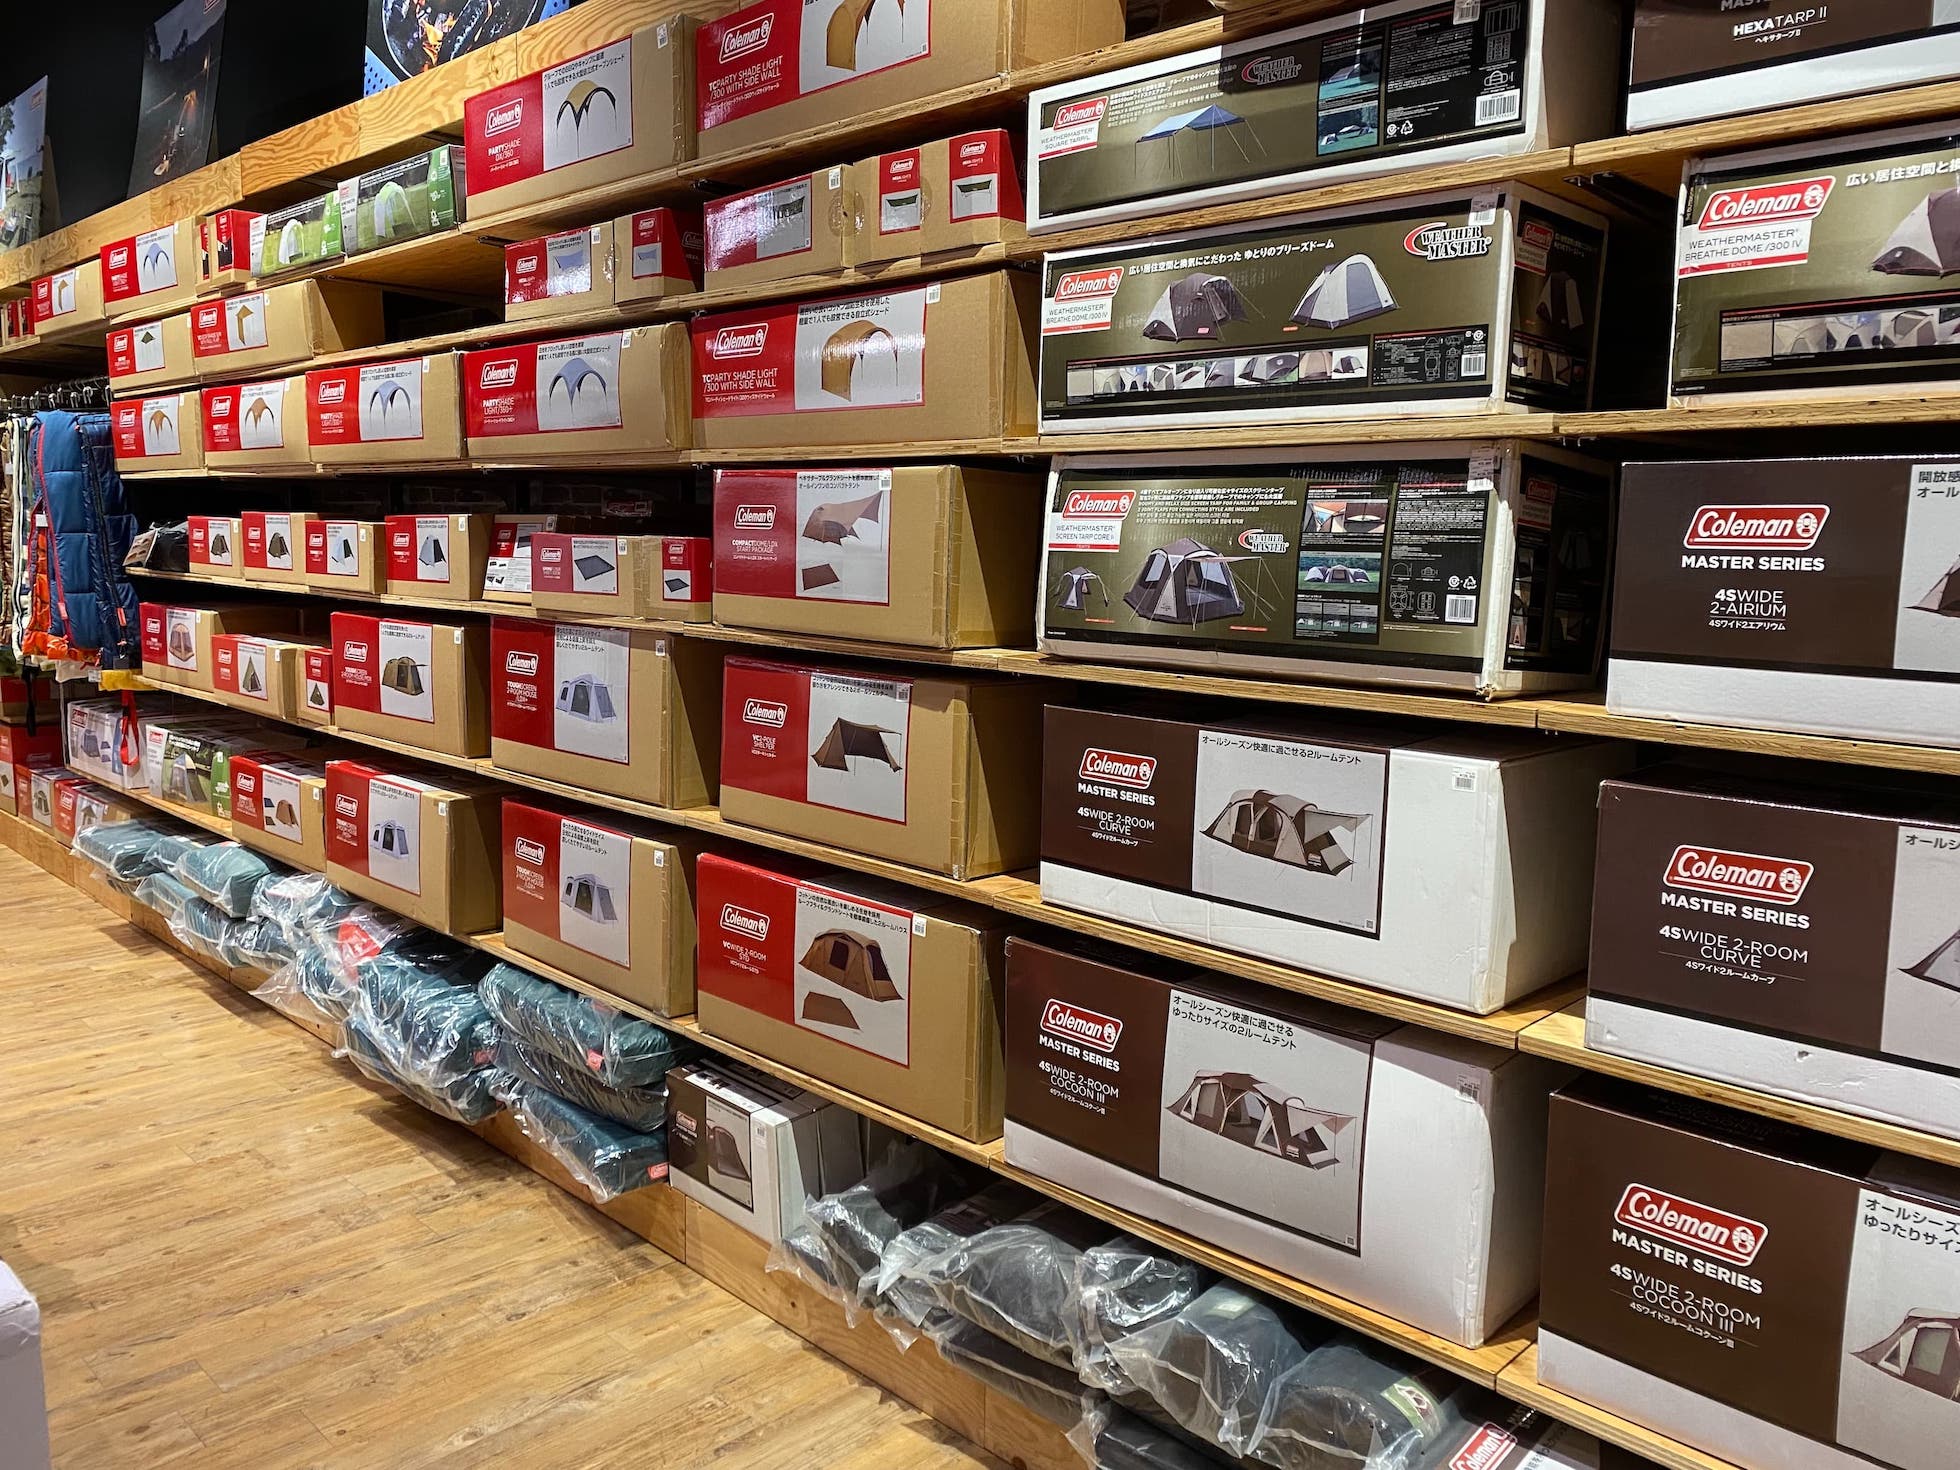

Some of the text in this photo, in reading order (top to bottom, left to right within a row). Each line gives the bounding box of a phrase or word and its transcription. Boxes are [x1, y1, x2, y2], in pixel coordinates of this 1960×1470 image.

[1733, 7, 1815, 36] HEXATARP
[725, 28, 760, 53] Coleman
[738, 66, 761, 82] SHADE
[762, 56, 783, 74] LIGHT
[726, 82, 744, 95] WITH
[744, 76, 760, 91] SIDE
[761, 69, 781, 83] WALL
[488, 108, 514, 130] Coleman
[1058, 104, 1096, 125] Coleman
[1709, 192, 1800, 221] Coleman
[1421, 226, 1482, 246] WEATHER
[1129, 239, 1335, 276] 広い居住空間と換気にこだわった ゆとりのブリーズドーム
[1685, 248, 1730, 262] BREATHE
[1060, 276, 1107, 296] Coleman
[719, 330, 754, 349] Coleman
[485, 366, 510, 381] Coleman
[702, 368, 778, 384] TCPARTY SHADE LIGHT
[720, 381, 737, 390] WITH
[738, 380, 755, 388] SIDE
[757, 378, 777, 387] WALL
[737, 508, 766, 523] Coleman
[1069, 493, 1118, 514] Coleman
[1697, 511, 1793, 537] Coleman
[1681, 554, 1825, 571] MASTER SERIES
[1714, 588, 1784, 603] 4SWIDE
[1710, 601, 1786, 617] 2-AIRIUM
[1708, 619, 1786, 631] 4Sワイド2エアリウム
[509, 654, 535, 669] Coleman
[747, 703, 776, 719] Coleman
[1202, 735, 1362, 765] オールシーズン快適に過ごせる2ルームテント
[1086, 752, 1138, 778] Coleman
[1078, 783, 1155, 805] MASTER SERIES
[1077, 807, 1154, 830] 4SWIDE 2-ROOM
[1099, 821, 1131, 836] CURVE
[517, 839, 543, 860] Coleman
[1676, 852, 1776, 888] Coleman
[724, 909, 758, 931] Coleman
[1660, 892, 1810, 929] MASTER SERIES
[745, 948, 766, 961] 2-ROOM
[1659, 925, 1809, 963] 4SWIDE 2-ROOM
[1699, 945, 1762, 969] CURVE
[1685, 960, 1776, 984] 4Sワイド2ルームカーブ
[1048, 1004, 1102, 1039] Coleman
[1173, 995, 1295, 1038] オールシーズン快適に過ごせる
[1172, 1007, 1298, 1051] ゆったりサイズの2ルームテント
[1039, 1034, 1120, 1073] MASTER SERIES
[1039, 1060, 1119, 1099] 4SWIDE 2-ROOM
[1050, 1075, 1094, 1102] COCOON
[1629, 1191, 1730, 1247] Coleman
[1611, 1228, 1763, 1295] MASTER SERIES
[1609, 1263, 1761, 1330] 4SWIDE 2-ROOM
[1632, 1285, 1735, 1334] COCOON III
